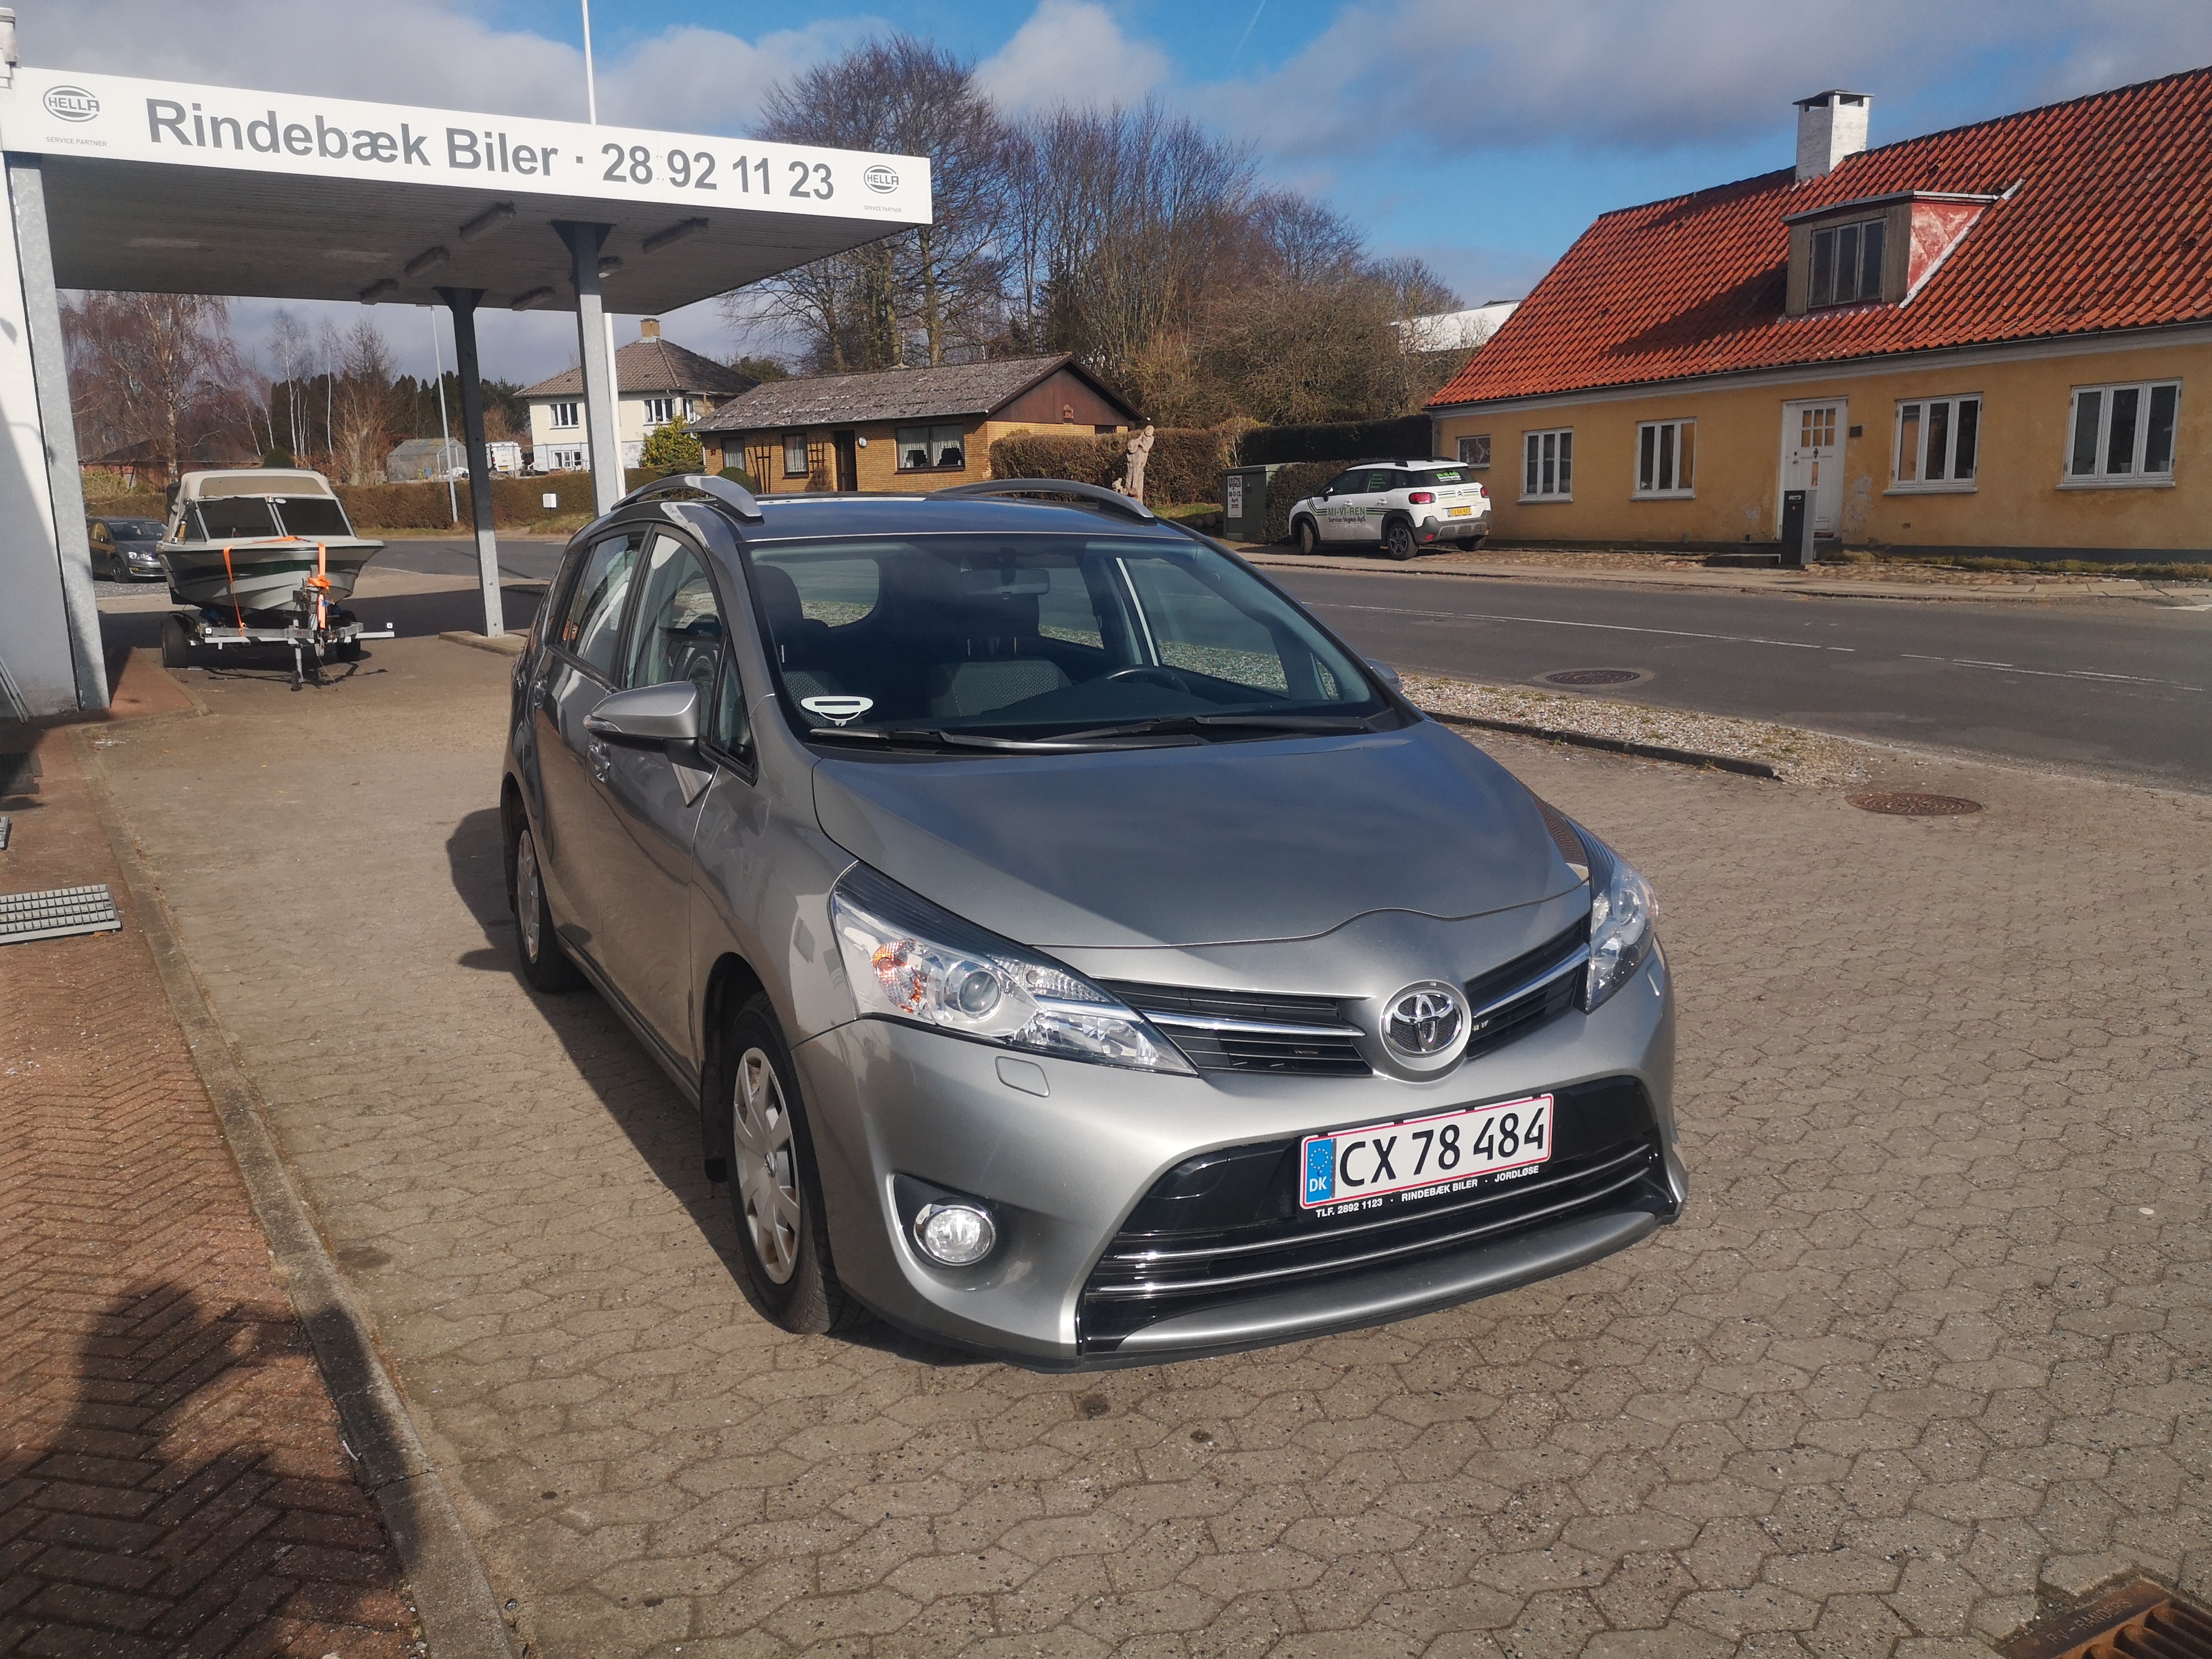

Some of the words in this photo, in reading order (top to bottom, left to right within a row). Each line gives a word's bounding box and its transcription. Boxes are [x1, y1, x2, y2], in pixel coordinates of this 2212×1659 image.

[48, 97, 100, 112] HELLA
[146, 98, 431, 166] Rindebæk
[445, 127, 559, 176] Biler
[601, 143, 653, 185] 28
[667, 149, 717, 190] 92
[733, 156, 770, 195] 11
[788, 161, 834, 201] 23
[867, 174, 899, 186] HELLA
[1328, 507, 1365, 516] MI-VI-REN
[1340, 1136, 1398, 1187] CX
[1412, 1124, 1461, 1176] 78
[1473, 1107, 1545, 1161] 484
[1309, 1176, 1327, 1192] DK
[1315, 1207, 1335, 1218] TLF.
[1337, 1202, 1359, 1214] 2892
[1362, 1198, 1382, 1210] 1123
[1401, 1184, 1451, 1202] RINDEBÆK
[1453, 1179, 1478, 1192] BILER
[1495, 1166, 1539, 1182] JORDLØSE
